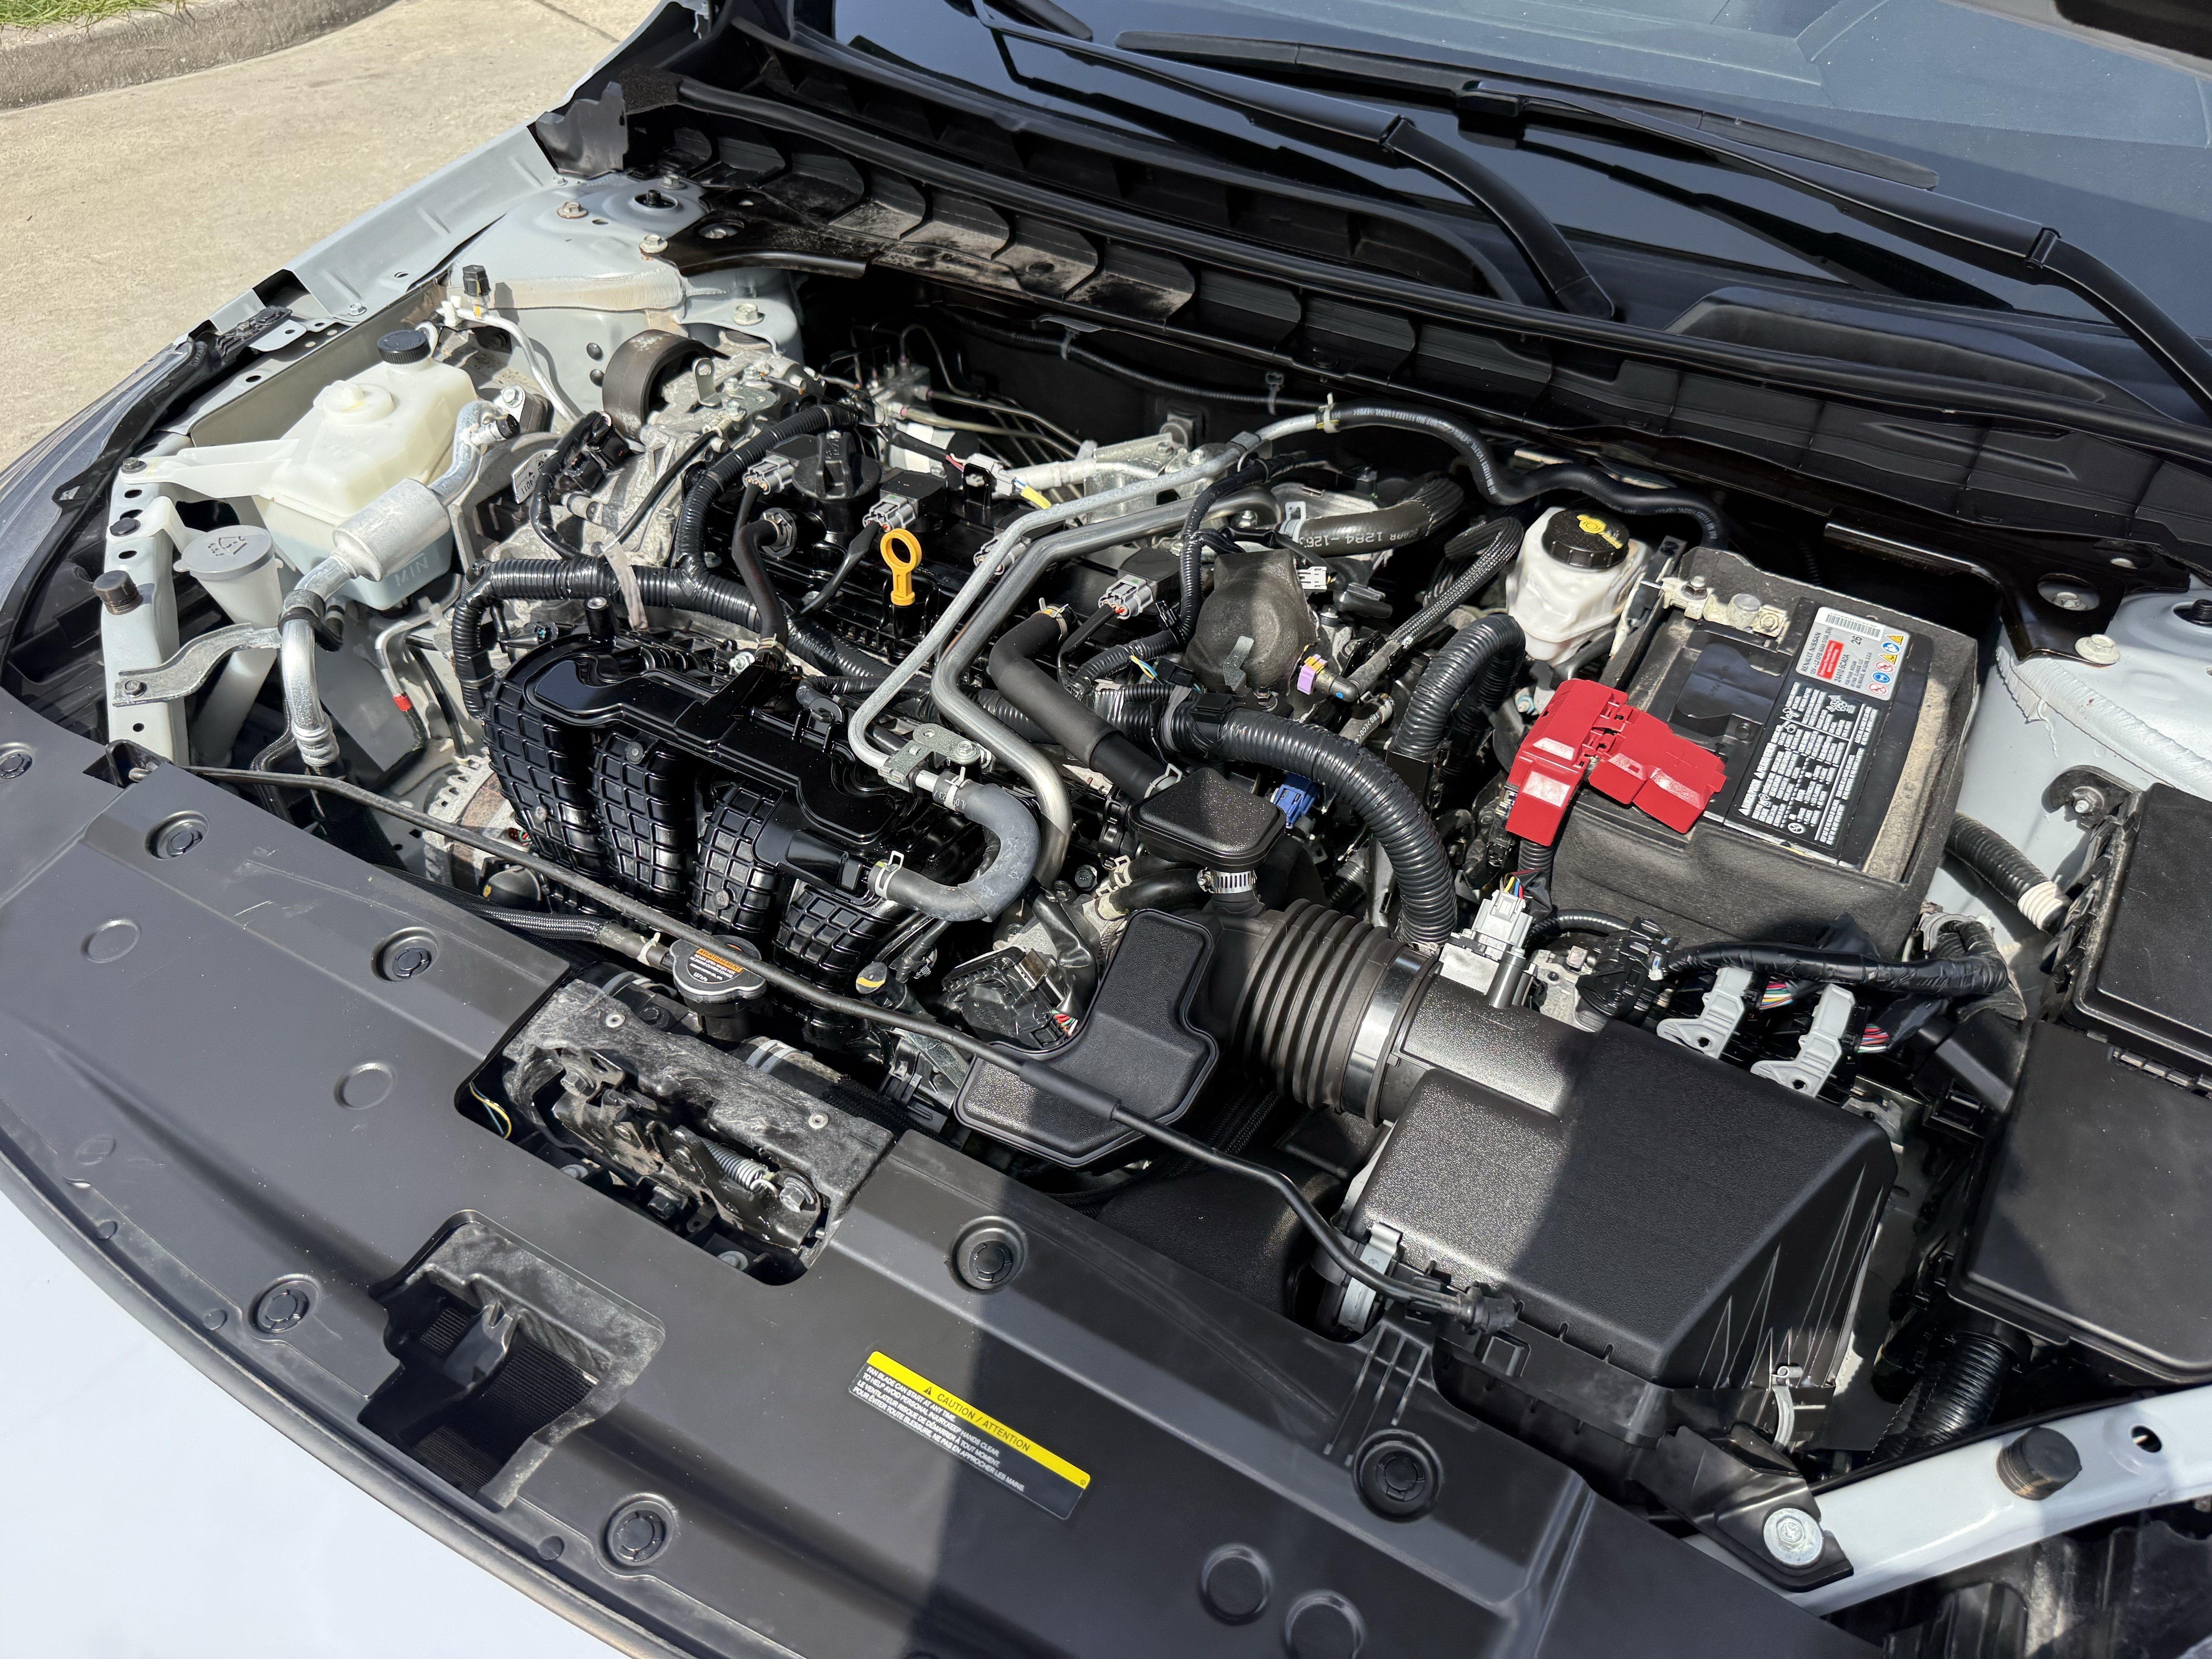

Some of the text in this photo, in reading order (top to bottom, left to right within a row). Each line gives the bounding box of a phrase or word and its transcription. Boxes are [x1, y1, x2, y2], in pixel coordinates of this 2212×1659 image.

[395, 555, 429, 587] MIN
[1801, 632, 1821, 672] RENAULT NISSAN
[1851, 635, 1862, 645] 26
[1834, 669, 1844, 682] 24410
[863, 1372, 871, 1381] TO
[870, 1377, 885, 1388] HELP
[883, 1386, 901, 1398] AVOID
[900, 1395, 928, 1415] PERSONAL
[960, 1430, 981, 1445] HANDS
[866, 1366, 878, 1376] FAN
[877, 1372, 896, 1386] BLADE
[895, 1382, 907, 1393] CAN
[906, 1389, 924, 1402] START
[929, 1404, 943, 1413] ANY
[853, 1386, 869, 1399] POUR
[868, 1394, 888, 1410] ÉVITER
[886, 1405, 905, 1420] TOUTE
[932, 1433, 942, 1442] NE
[940, 1438, 953, 1449] PAS
[951, 1444, 961, 1453] EN
[959, 1450, 995, 1474] APPROCHER
[994, 1470, 1006, 1480] LES
[857, 1379, 866, 1388] LE
[865, 1384, 898, 1407] VENTILATEUR
[897, 1403, 919, 1419] RISQUE
[917, 1415, 927, 1424] DE
[925, 1420, 956, 1441] DÉMARRER
[960, 1440, 976, 1452] TOUT
[937, 1393, 976, 1420] CAUTION
[982, 1420, 1030, 1451] ATTENTION
